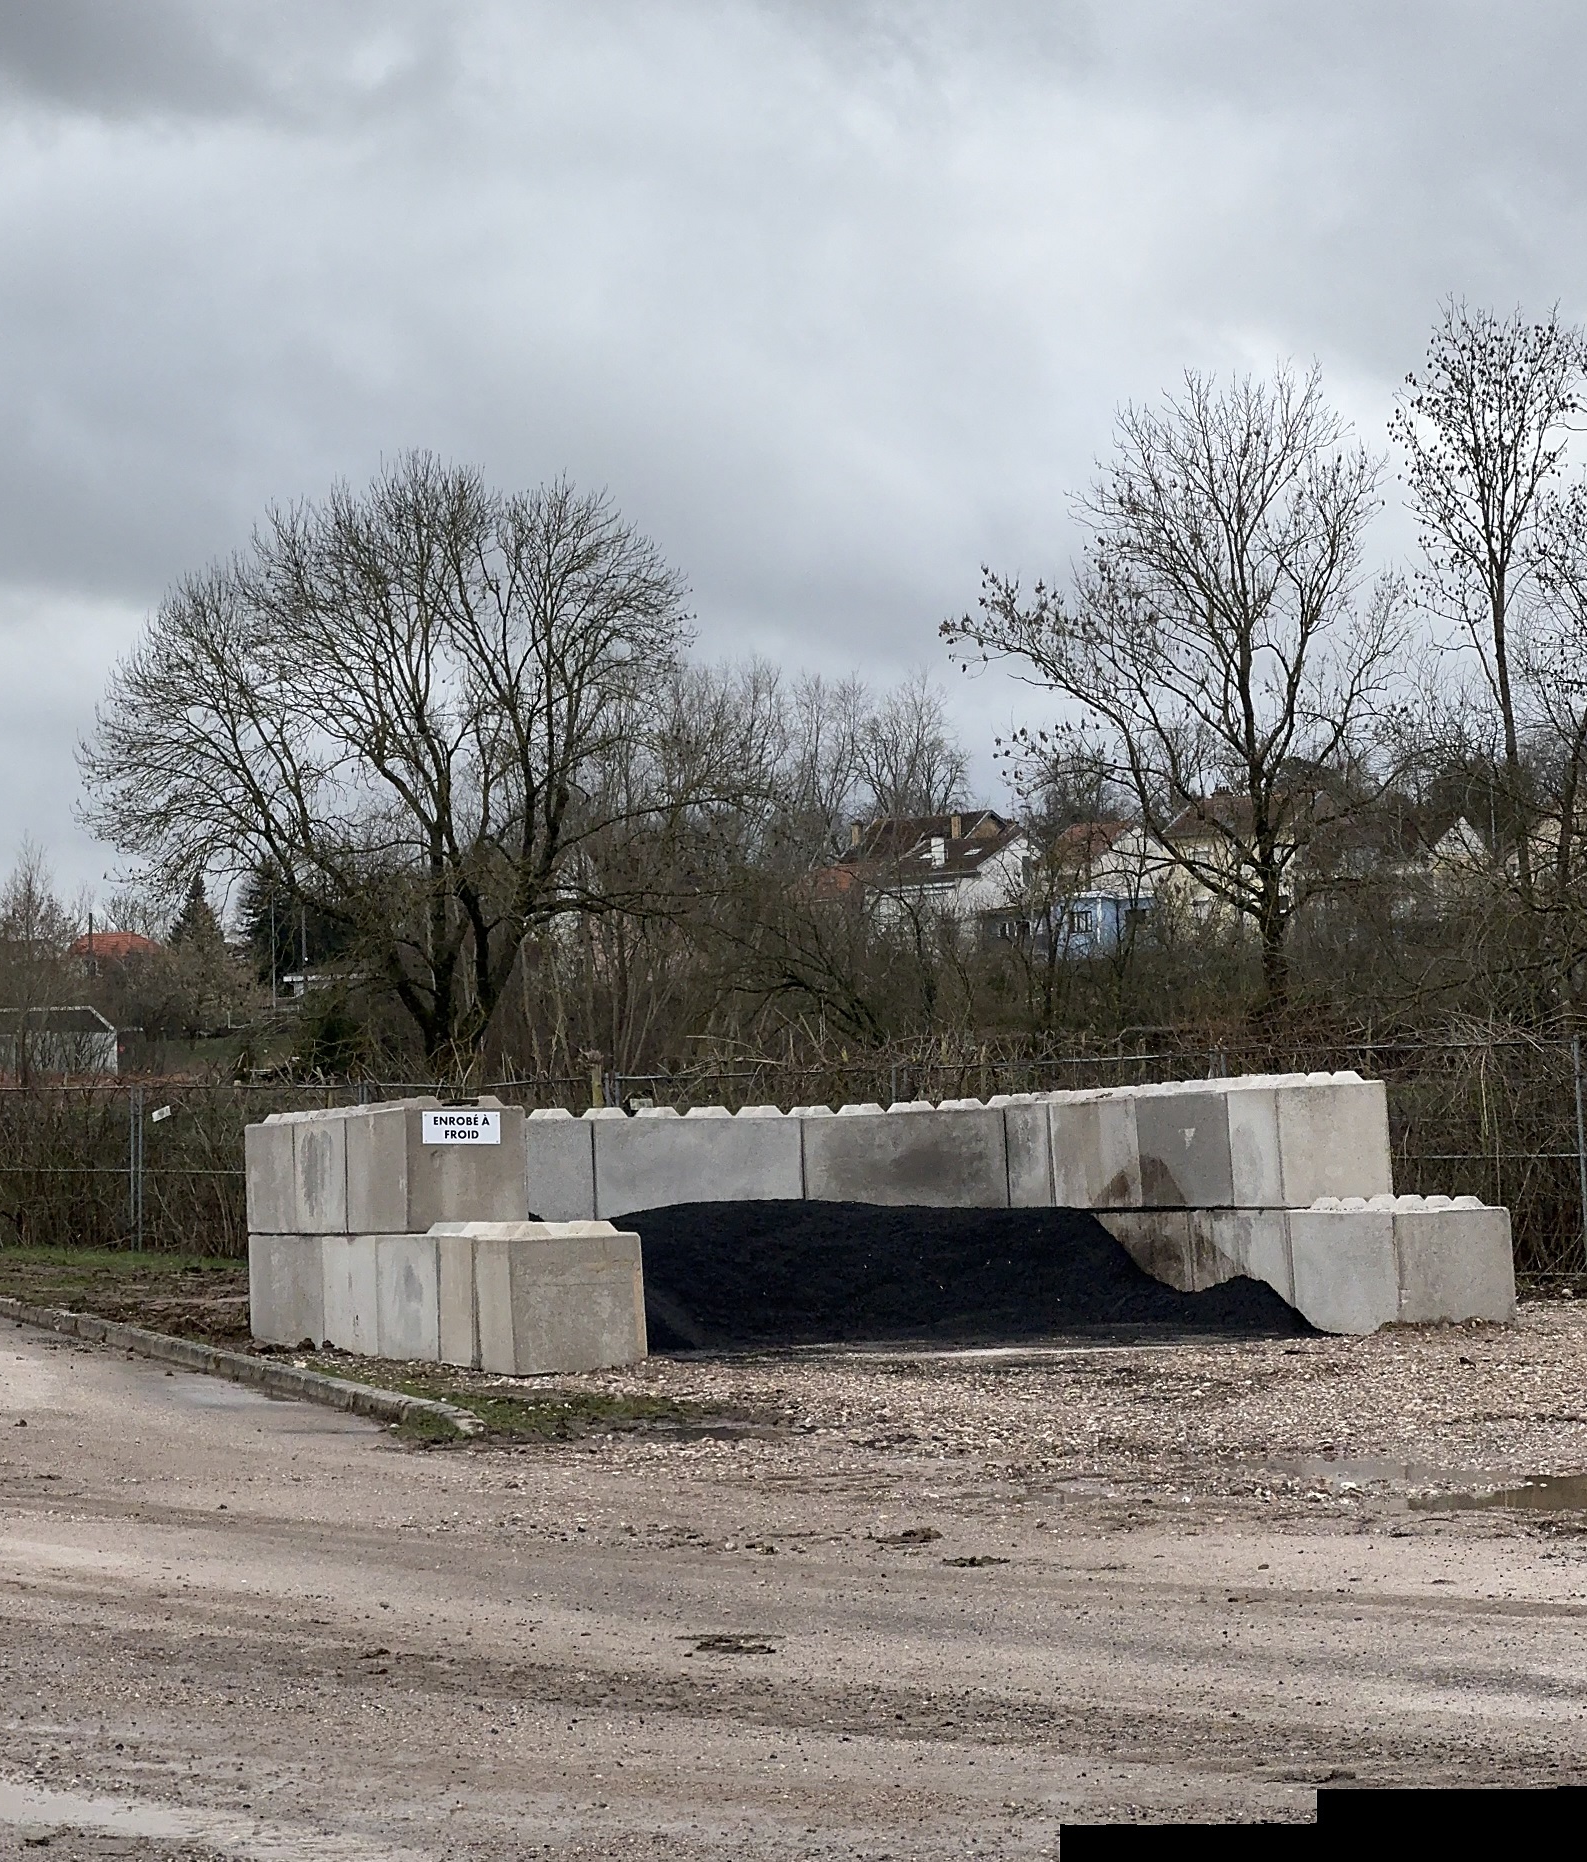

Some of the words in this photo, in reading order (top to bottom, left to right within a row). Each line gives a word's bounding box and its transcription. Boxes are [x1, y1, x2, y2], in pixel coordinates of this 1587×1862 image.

[433, 1113, 479, 1126] ENROBÉ
[481, 1113, 490, 1126] À
[444, 1129, 479, 1139] FROID
